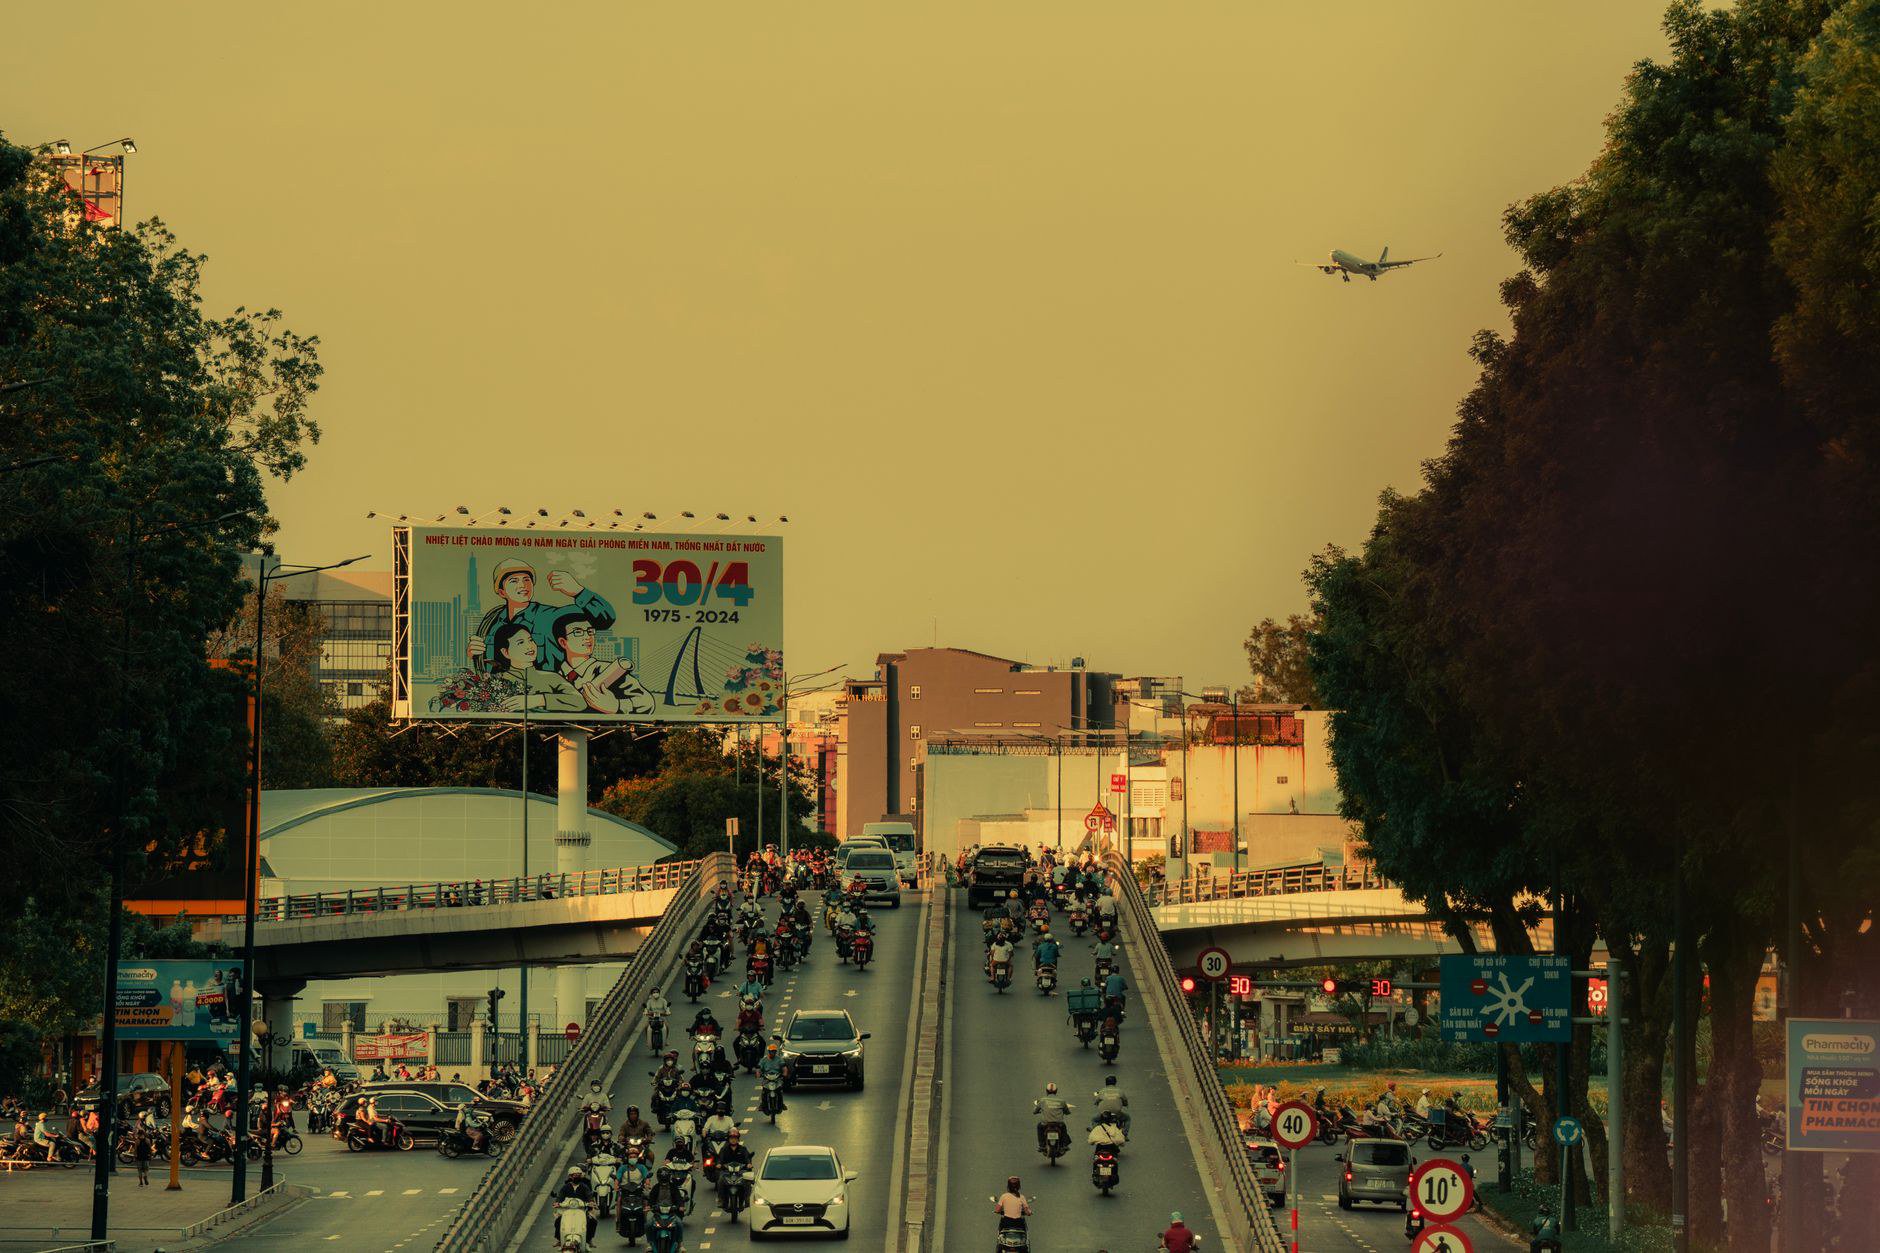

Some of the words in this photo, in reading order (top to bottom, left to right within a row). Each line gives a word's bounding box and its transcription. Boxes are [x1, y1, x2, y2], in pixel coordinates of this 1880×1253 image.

[426, 534, 450, 546] NHIỆT
[452, 534, 468, 547] LIỆT
[471, 535, 492, 546] CHÀO
[495, 535, 520, 546] MỪNG
[522, 538, 532, 547] 49
[534, 536, 553, 547] NĂM
[556, 536, 577, 548] NGÀY
[580, 536, 596, 548] GIẢI
[599, 537, 626, 549] PHÓNG
[628, 537, 649, 549] MIỀN
[652, 540, 672, 551] NAM,
[675, 538, 701, 550] THỐNG
[704, 539, 724, 551] NHẤT
[726, 540, 741, 552] ĐẤT
[744, 540, 766, 552] NƯỚC
[632, 559, 754, 607] 30/4
[644, 609, 681, 622] 1975
[696, 610, 740, 623] 2024
[1206, 957, 1221, 972] 30
[1230, 977, 1249, 994] 30
[1372, 980, 1390, 996] 30
[1806, 1037, 1870, 1052] Pharmacity
[1805, 1076, 1831, 1086] SỐNG
[1809, 1100, 1833, 1112] TIN
[1282, 1115, 1303, 1134] 40
